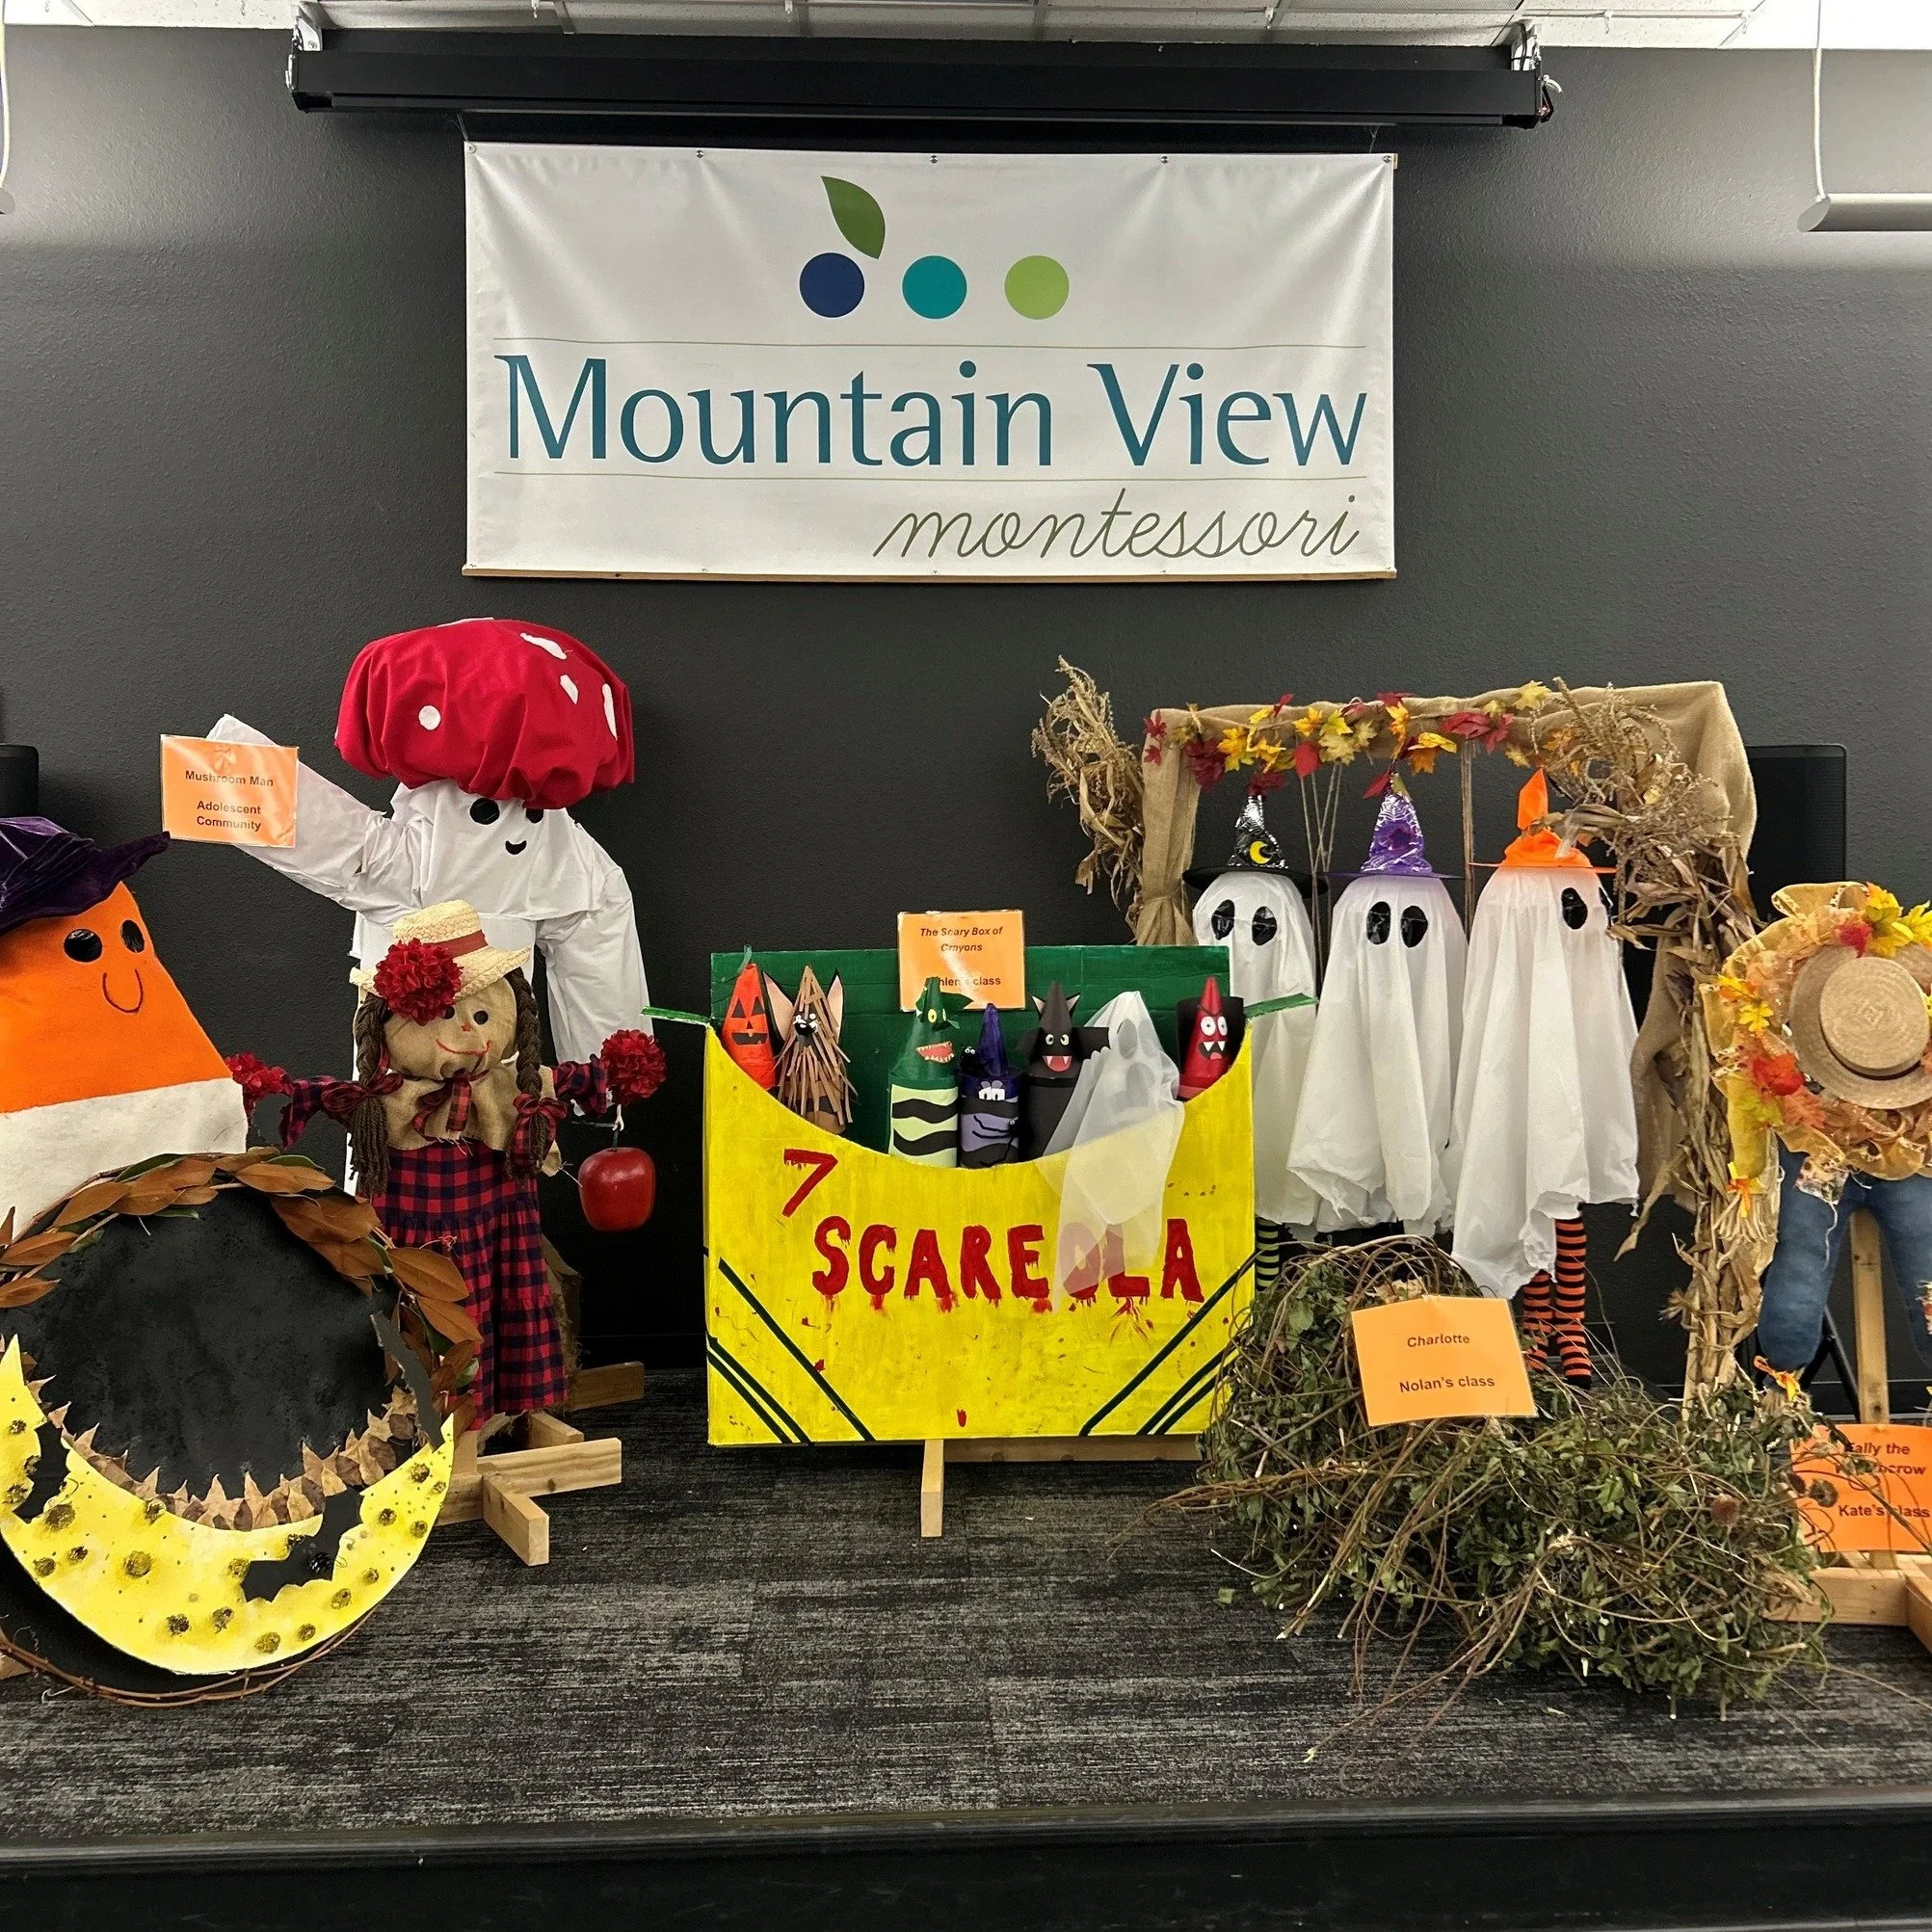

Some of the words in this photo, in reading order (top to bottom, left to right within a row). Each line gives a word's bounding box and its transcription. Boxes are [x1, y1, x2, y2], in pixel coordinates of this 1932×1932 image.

[494, 355, 1052, 466] Mountain
[1087, 361, 1367, 466] View
[873, 488, 1361, 559] montessori
[185, 770, 246, 785] Mushroom
[250, 776, 274, 787] Man
[197, 800, 261, 814] Adolescent
[197, 816, 261, 832] Community
[920, 928, 939, 937] The
[940, 927, 970, 938] Scary
[971, 927, 990, 936] Box
[992, 926, 1004, 935] of
[940, 942, 983, 953] Crayons
[973, 976, 1001, 986] class
[783, 1149, 838, 1218] 7
[812, 1215, 1205, 1305] SCAREOLA
[1407, 1334, 1470, 1348] Charlotte
[1399, 1377, 1454, 1392] Nolan's
[1458, 1375, 1495, 1388] class
[1886, 1442, 1911, 1455] the
[1838, 1504, 1885, 1518] Kate's
[1892, 1505, 1931, 1519] lass
